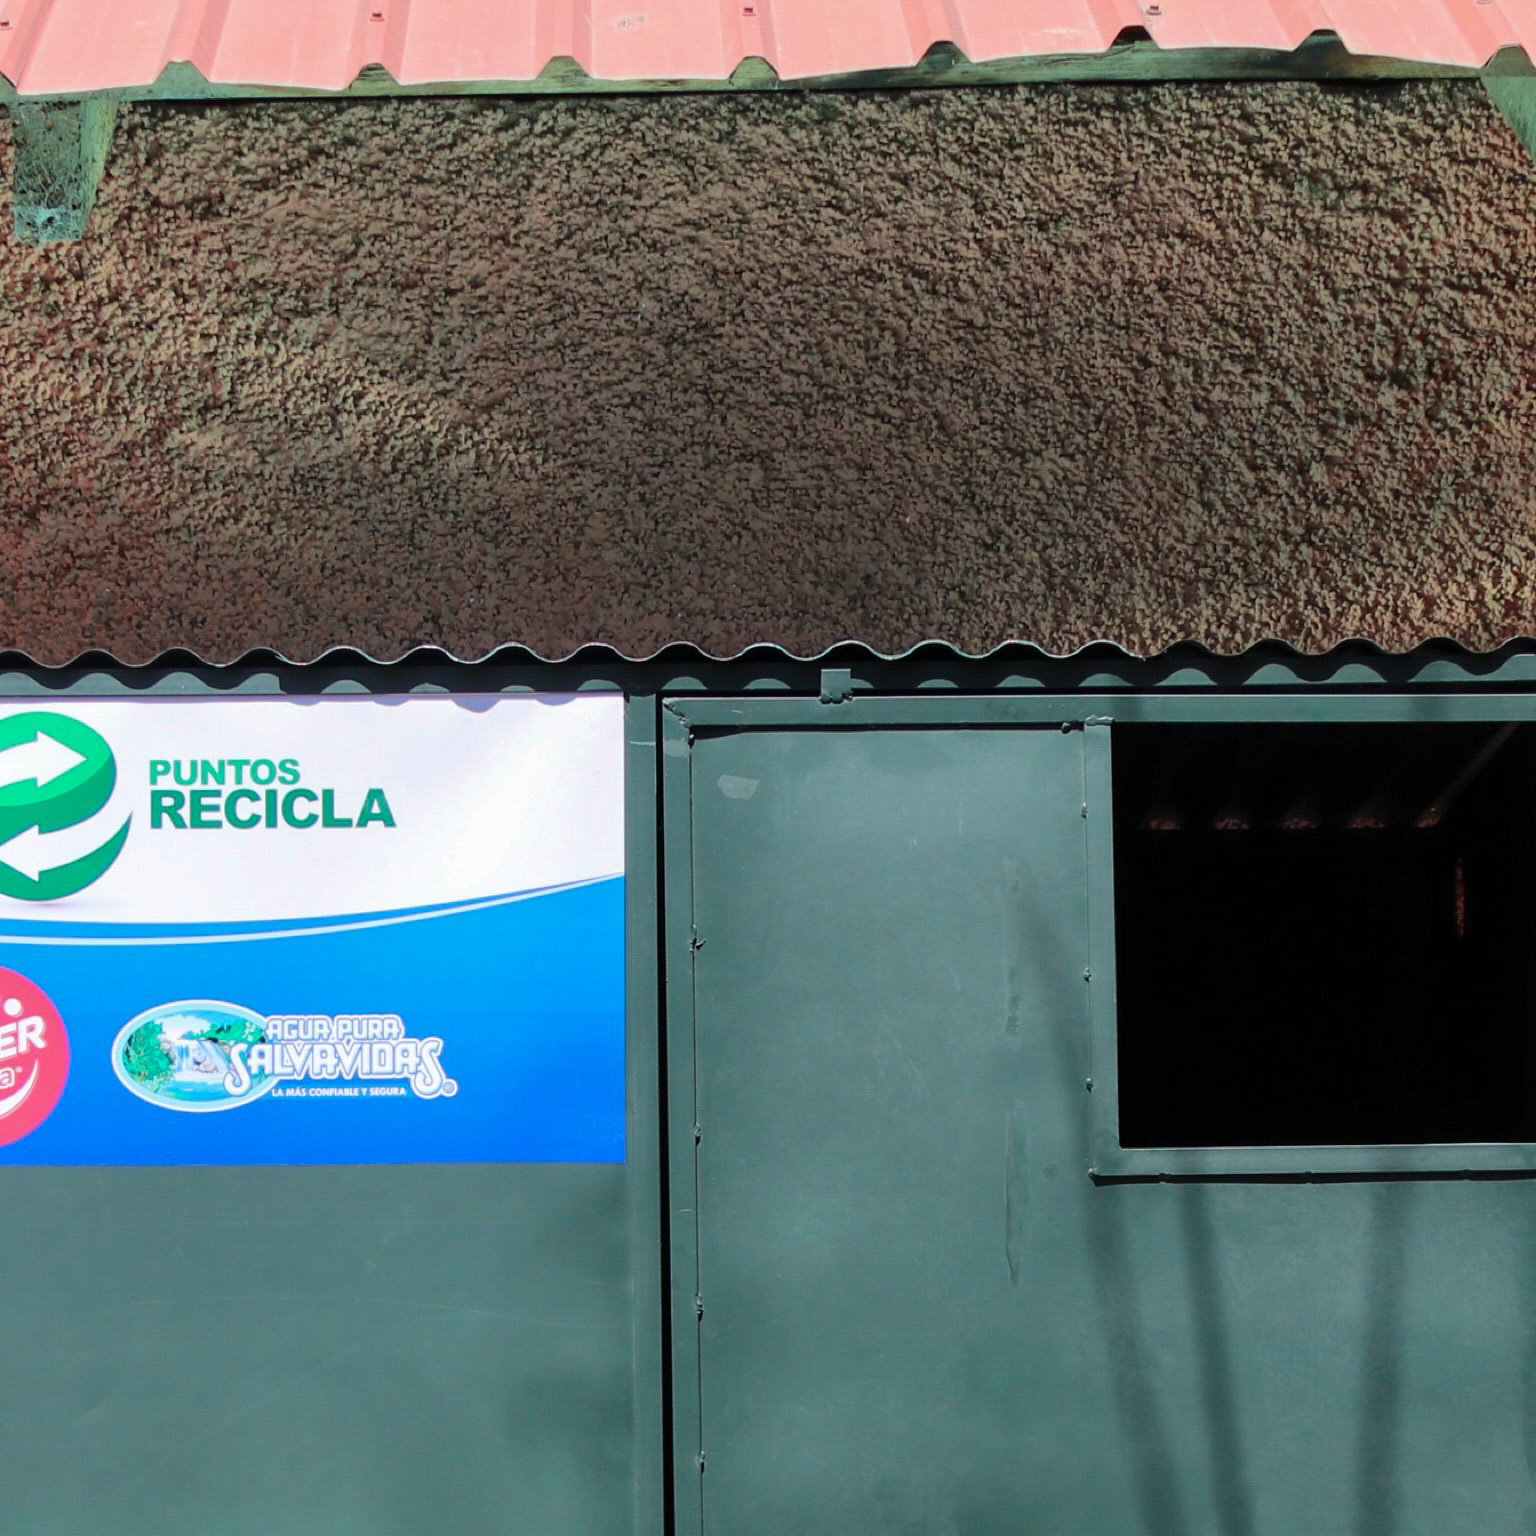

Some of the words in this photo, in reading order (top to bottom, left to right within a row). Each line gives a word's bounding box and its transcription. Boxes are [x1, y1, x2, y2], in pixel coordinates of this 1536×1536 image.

[149, 758, 301, 786] PUNTOS
[149, 787, 397, 830] RECICLA
[265, 1017, 332, 1041] AGUA
[336, 1016, 402, 1041] PURA
[223, 1039, 444, 1097] SALVAVIDAS
[271, 1087, 284, 1097] LA
[286, 1085, 307, 1097] MÁS
[308, 1086, 359, 1097] CONFIABLE
[360, 1086, 368, 1096] Y
[369, 1085, 407, 1096] SEGURA
